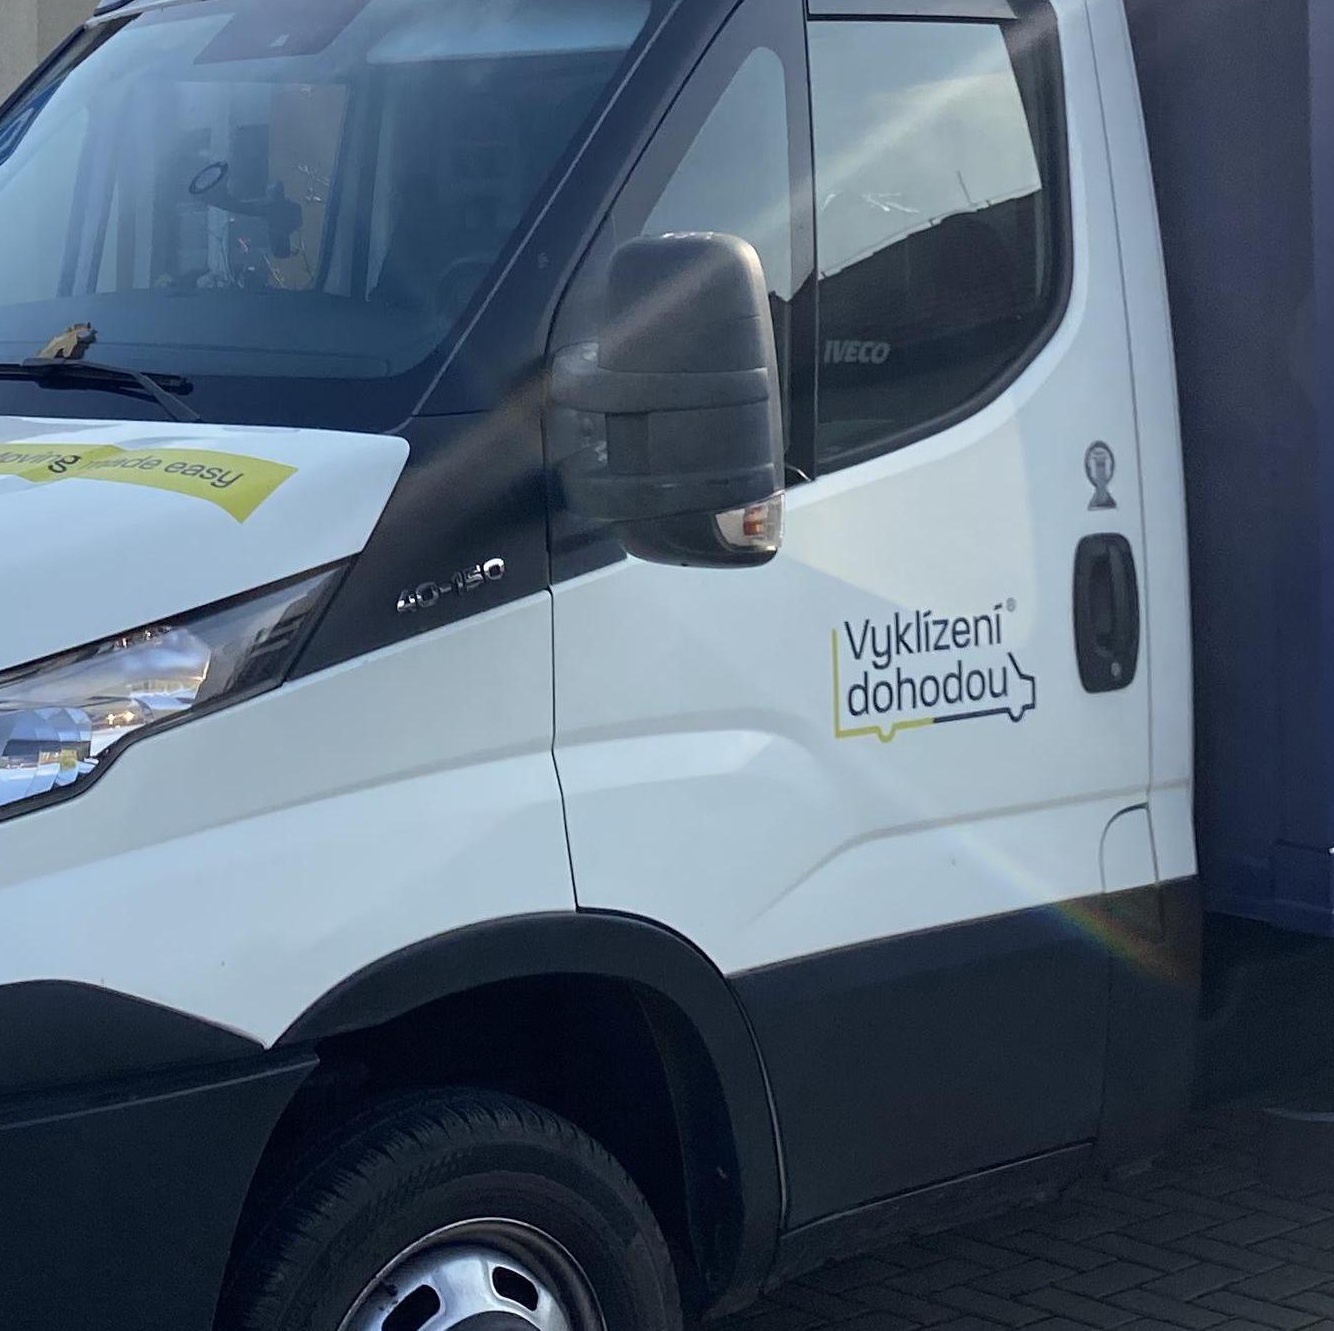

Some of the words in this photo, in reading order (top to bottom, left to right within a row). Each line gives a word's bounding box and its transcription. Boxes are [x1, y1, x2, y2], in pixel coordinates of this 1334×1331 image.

[824, 340, 891, 364] IVECO
[163, 459, 245, 489] easy
[848, 660, 1008, 716] dohodou
